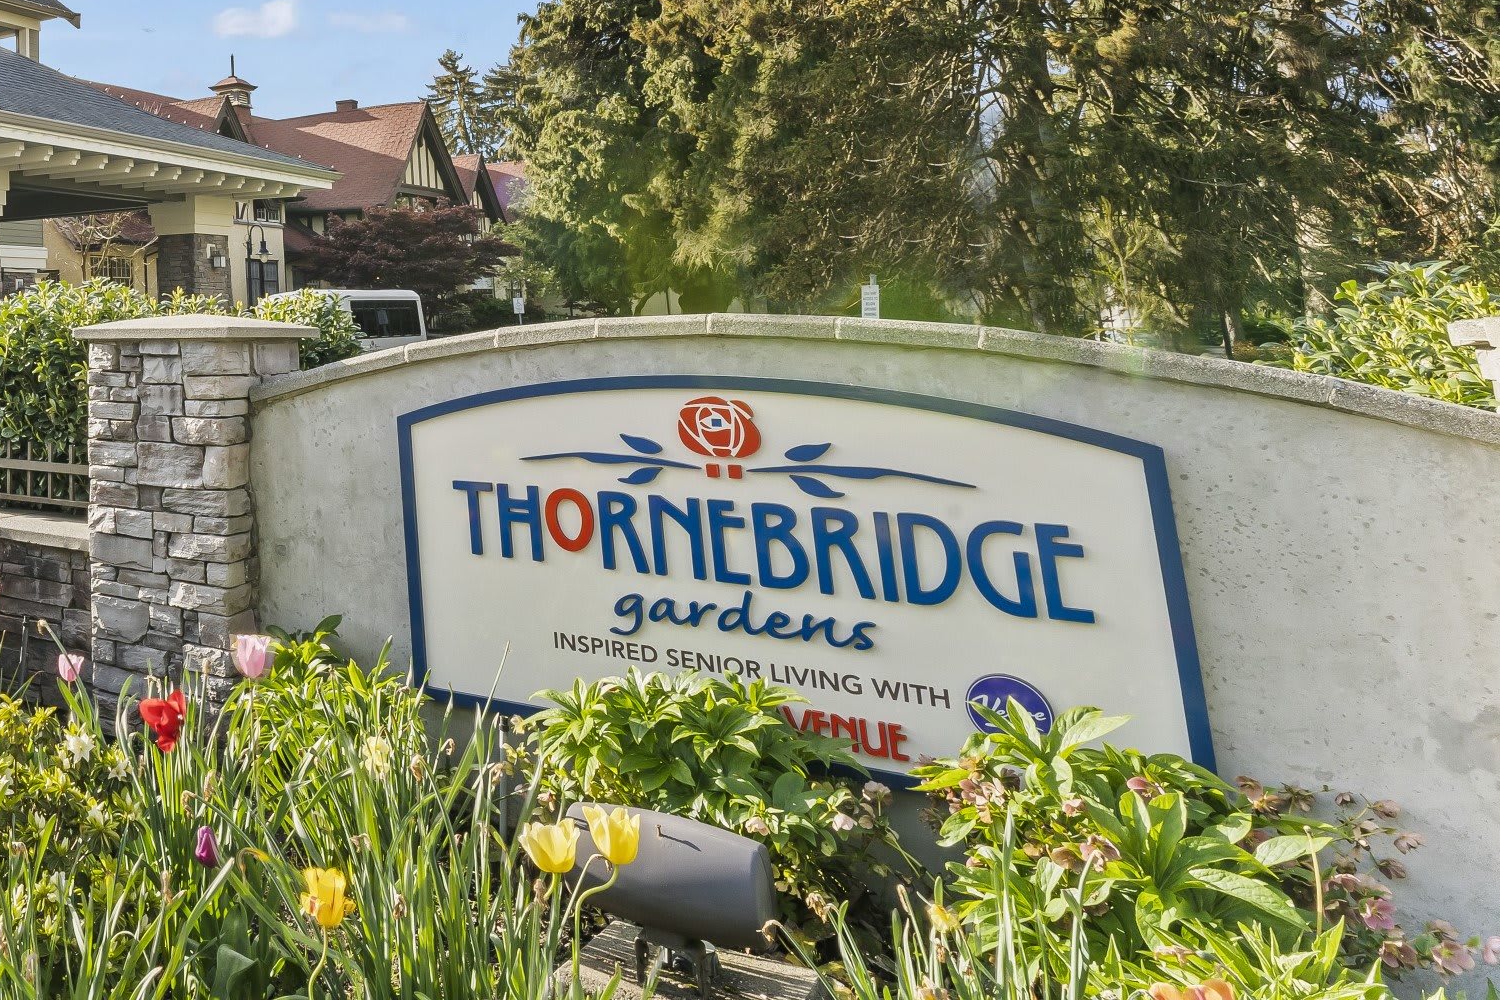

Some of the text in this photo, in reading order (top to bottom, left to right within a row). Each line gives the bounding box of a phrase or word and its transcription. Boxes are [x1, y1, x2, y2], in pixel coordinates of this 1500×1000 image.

[451, 479, 1096, 624] THORNEBRIDGE
[609, 589, 877, 651] gardens
[553, 631, 951, 710] INSPIRED SENIOR LIVING WITH
[781, 704, 910, 762] VENUE
